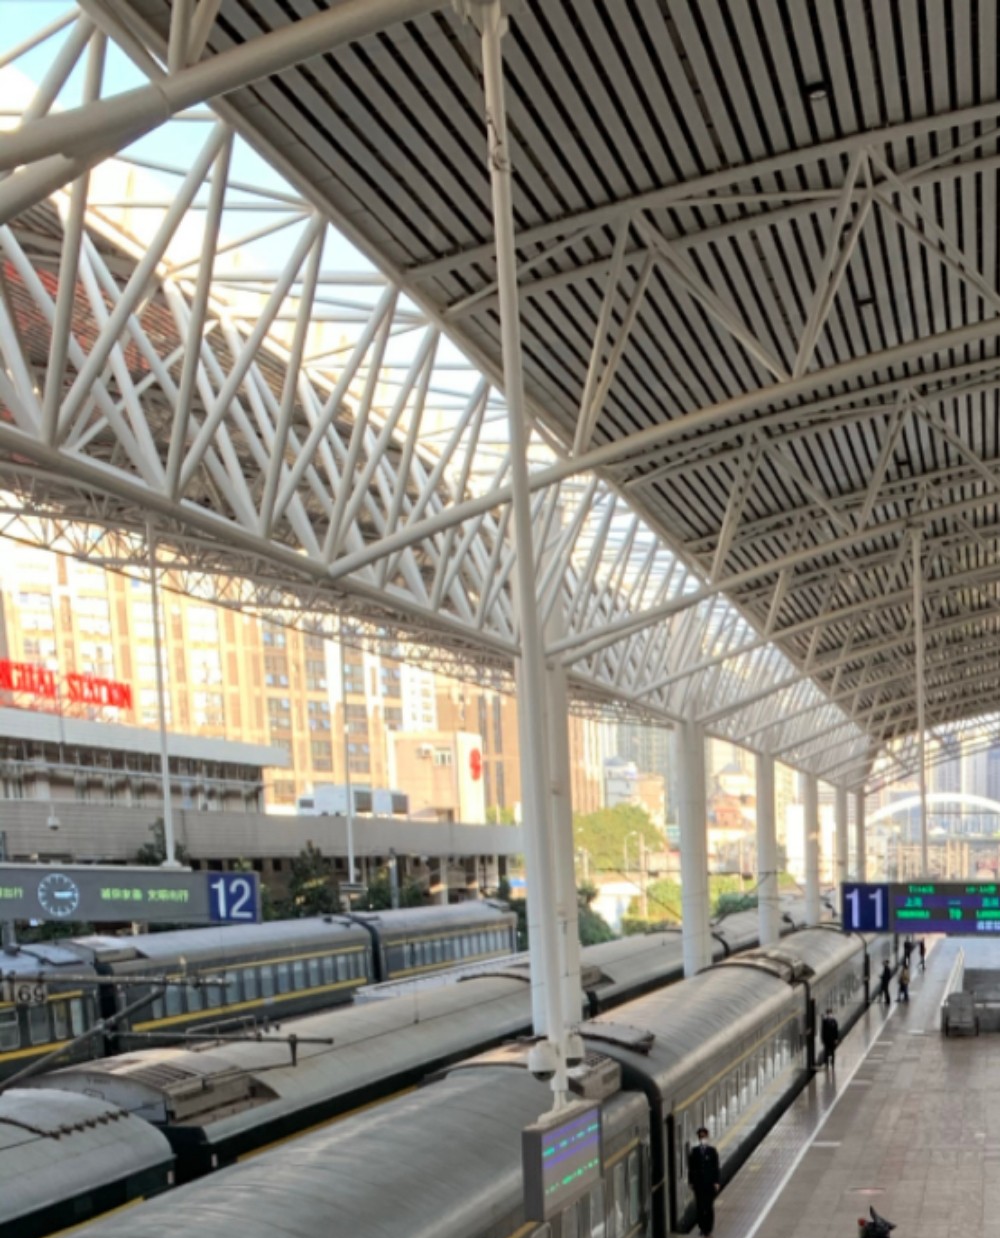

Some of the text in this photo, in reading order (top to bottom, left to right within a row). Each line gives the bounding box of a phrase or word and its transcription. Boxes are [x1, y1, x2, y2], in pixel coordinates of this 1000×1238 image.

[67, 673, 134, 711] STATION
[211, 878, 253, 919] 12
[846, 888, 884, 928] 11
